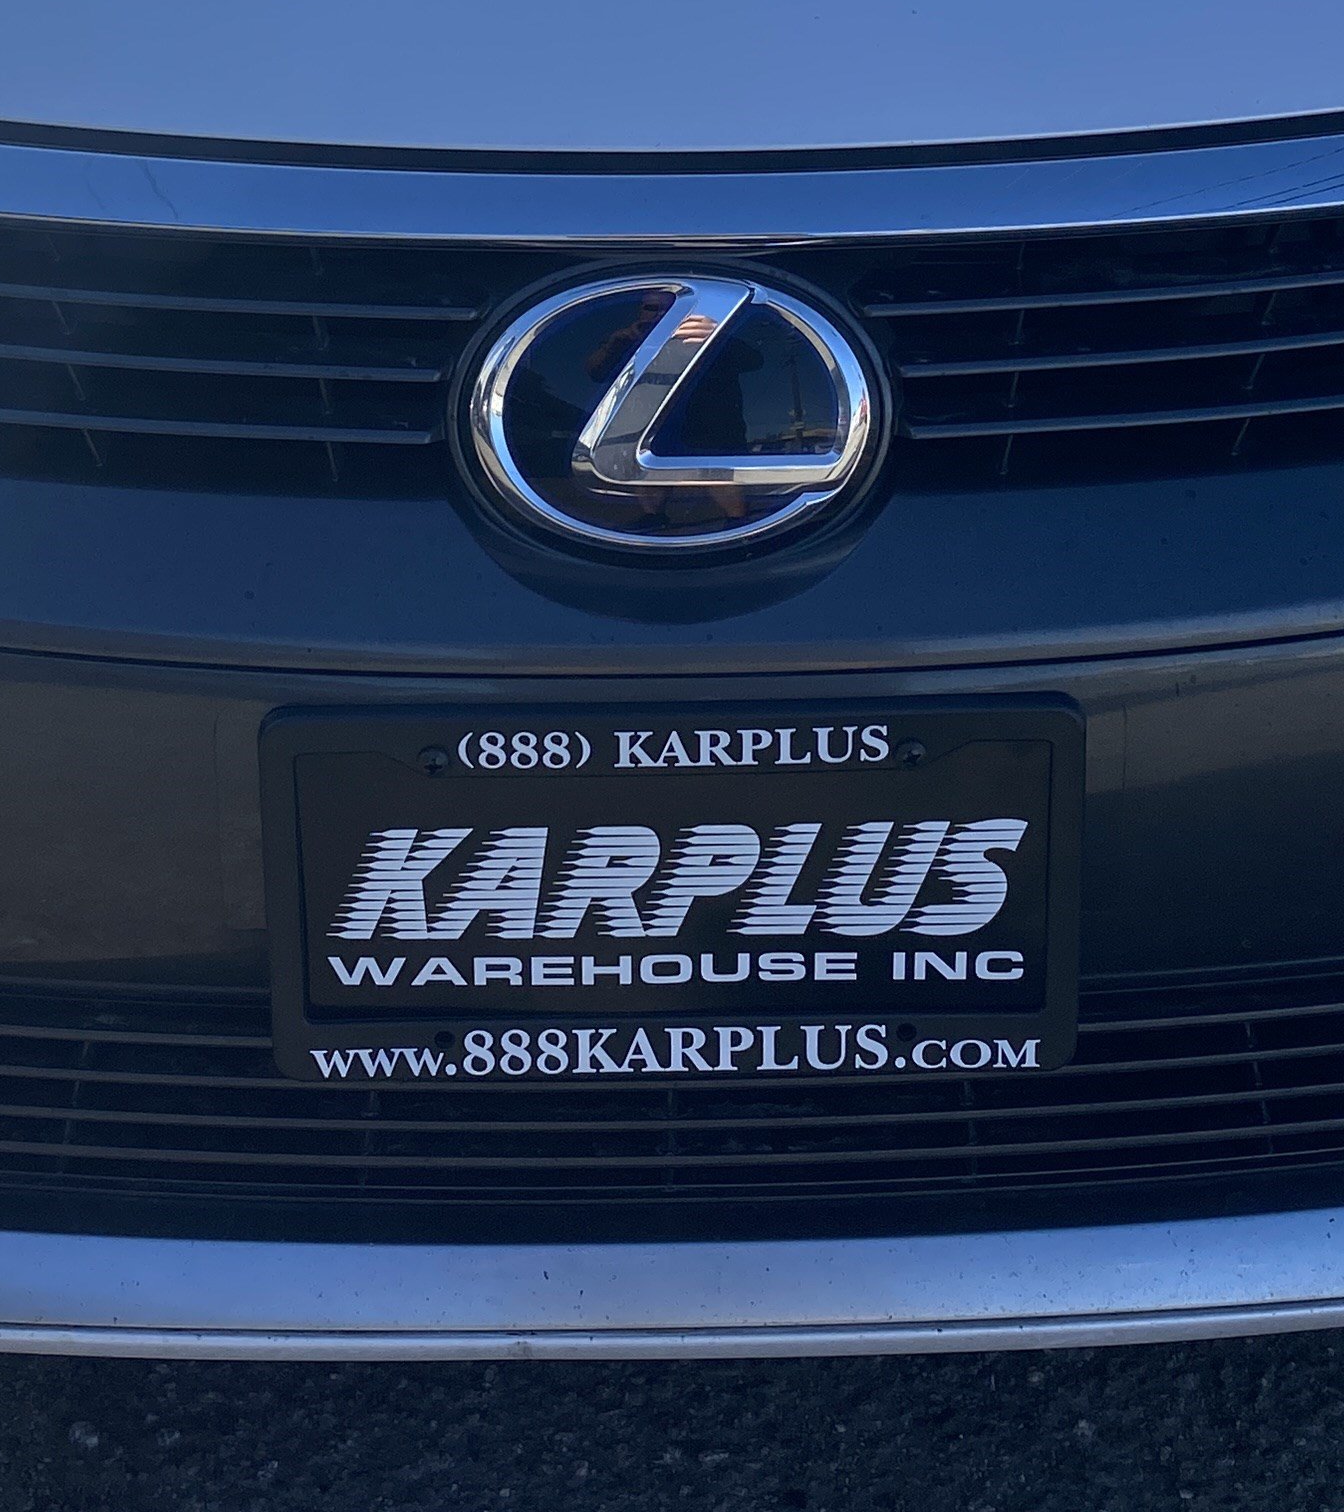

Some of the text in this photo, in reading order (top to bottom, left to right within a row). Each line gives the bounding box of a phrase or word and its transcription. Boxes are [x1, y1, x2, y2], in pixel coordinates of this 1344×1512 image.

[457, 724, 890, 770] (888) KARPLUS
[326, 818, 1029, 940] KARPLUS
[327, 950, 1025, 986] WAREHOUSE INC
